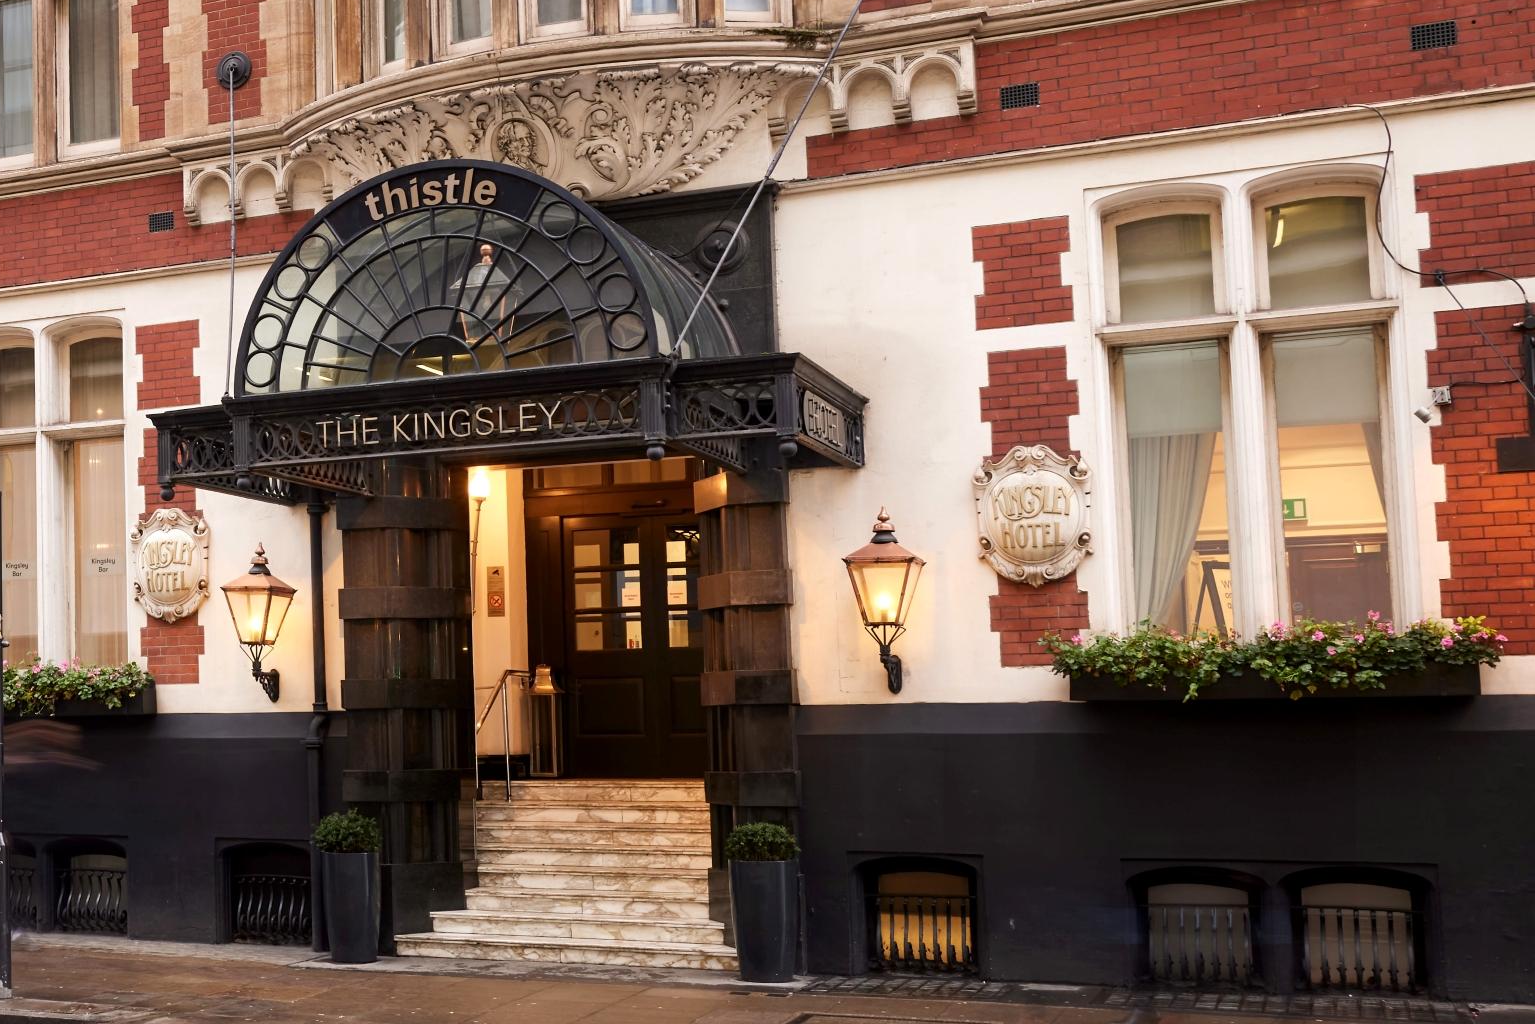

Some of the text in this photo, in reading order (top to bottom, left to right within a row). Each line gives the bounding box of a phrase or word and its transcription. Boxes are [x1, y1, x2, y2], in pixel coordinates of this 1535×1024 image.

[365, 168, 497, 221] thistle
[316, 400, 562, 448] THE KINGSLEY
[992, 485, 1074, 521] KINGSLEY
[1001, 522, 1066, 549] HOTEL
[147, 571, 189, 592] HOTEL
